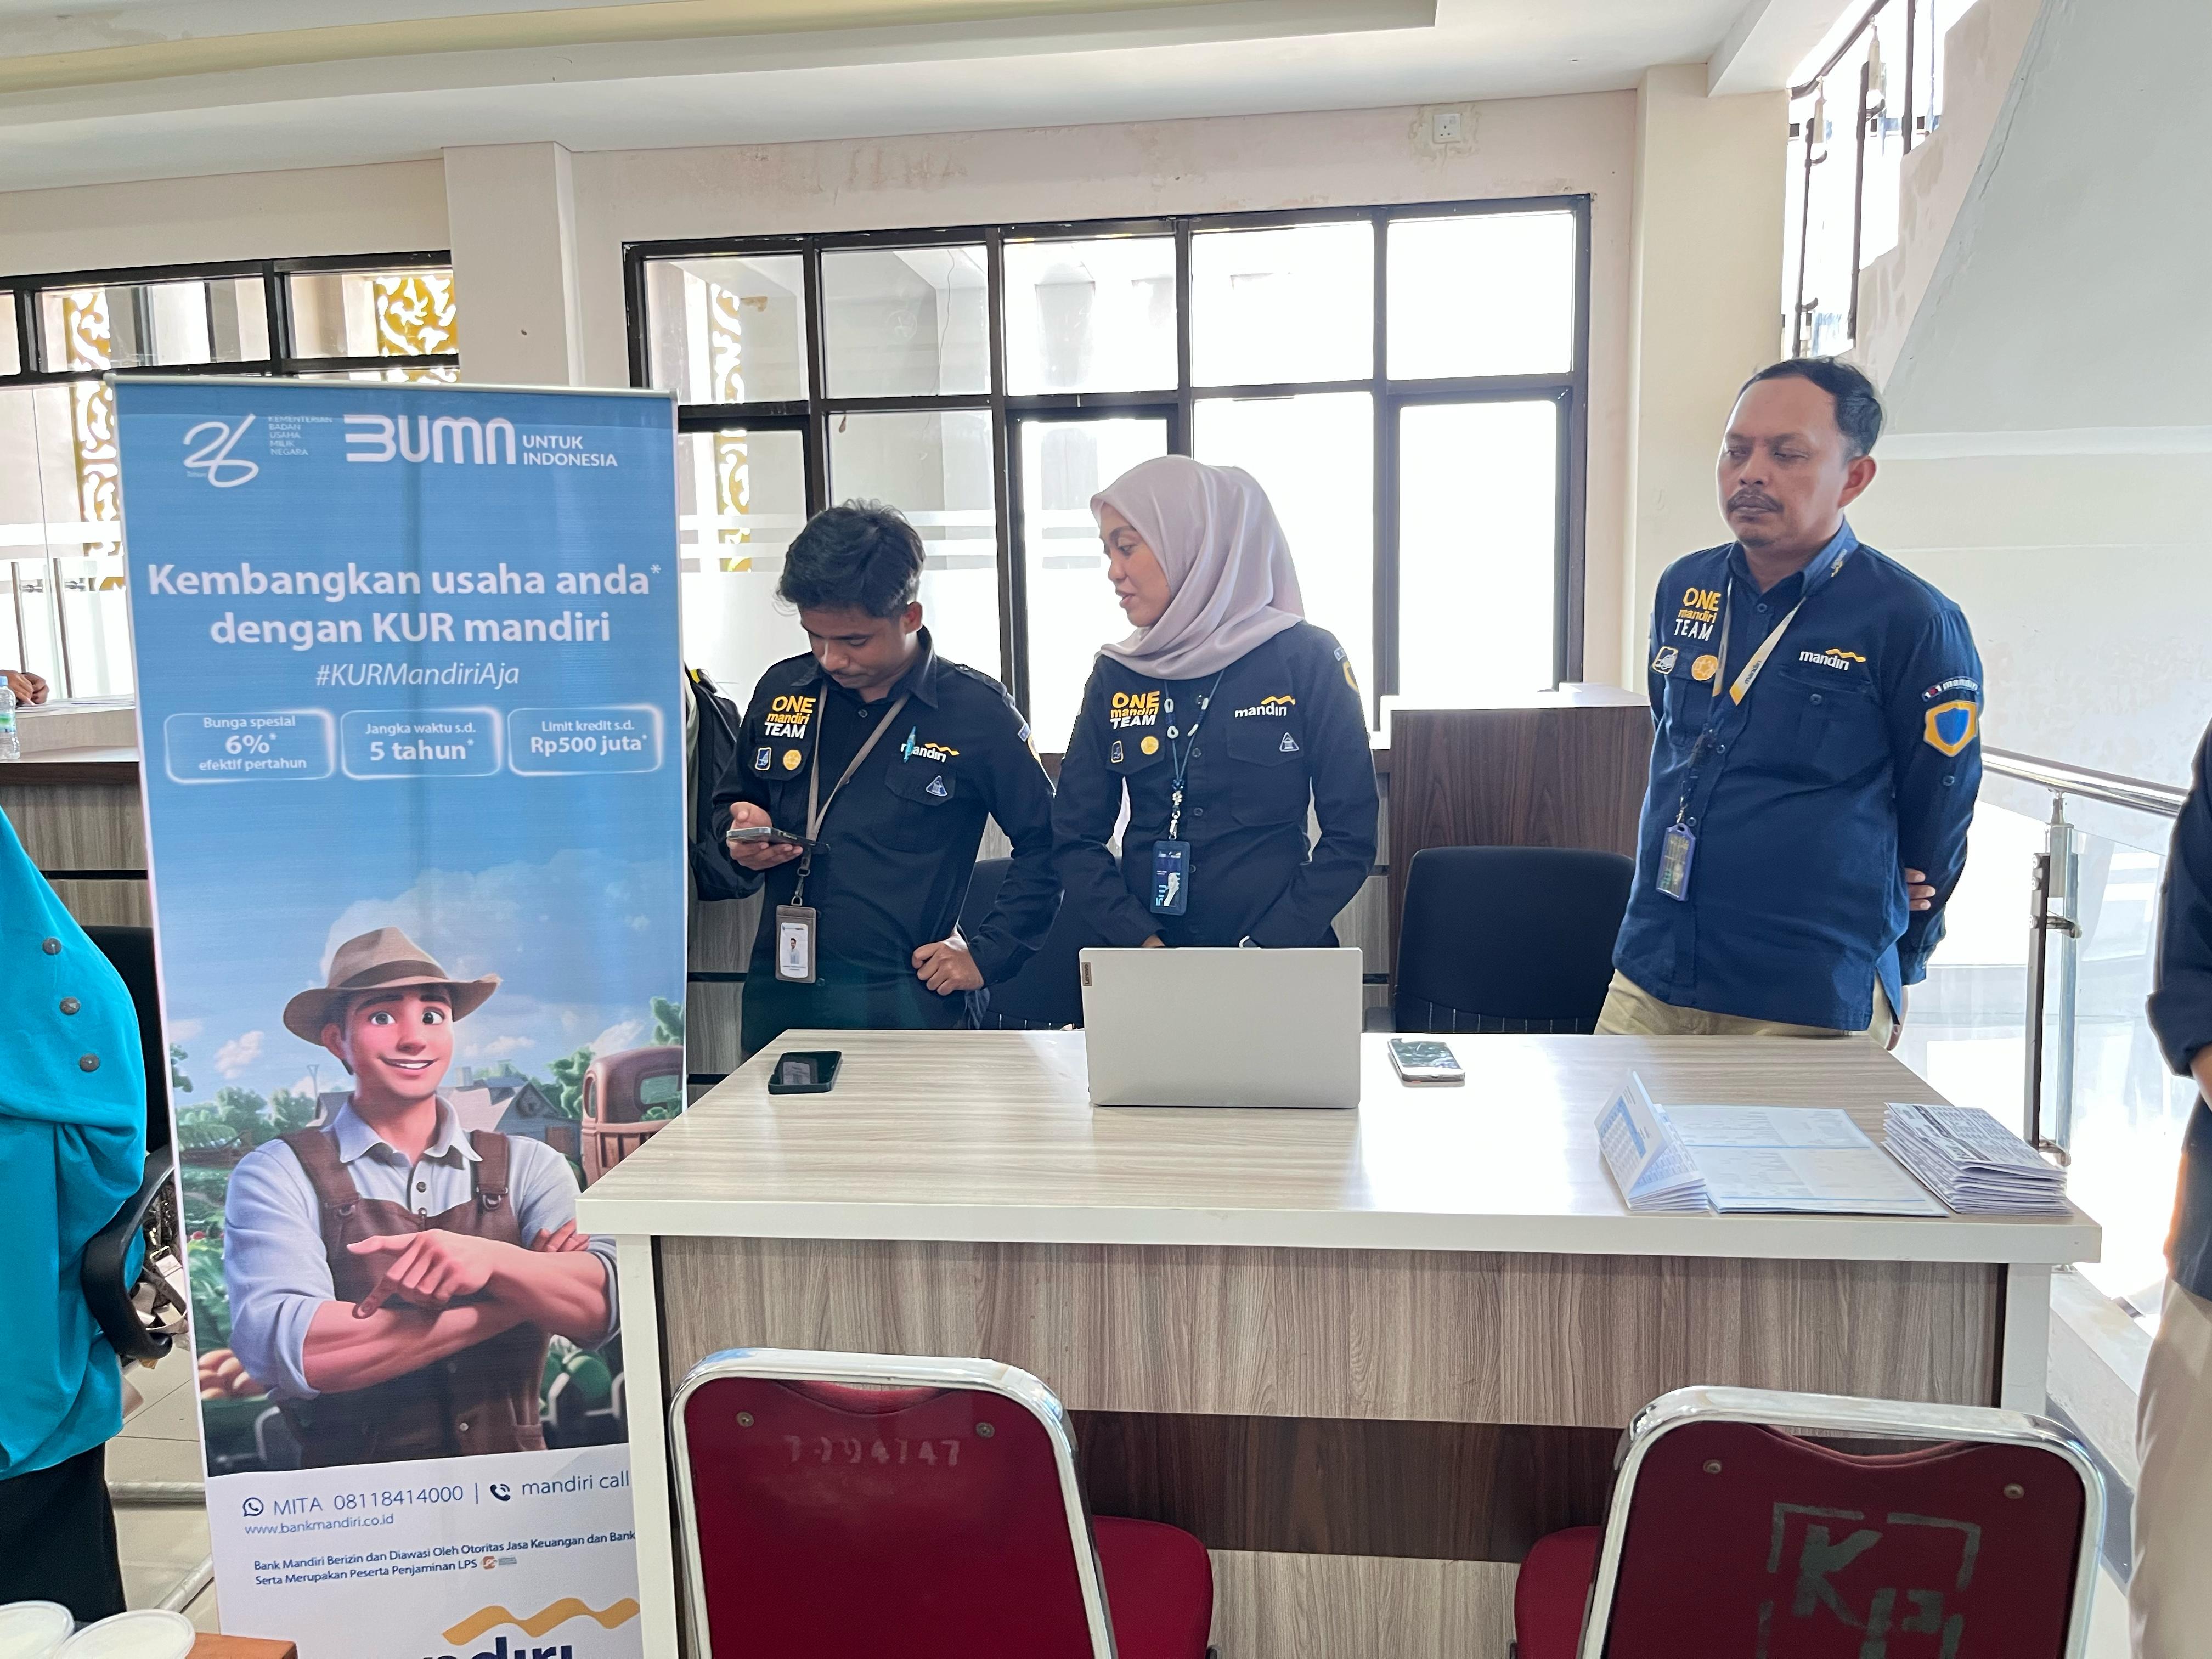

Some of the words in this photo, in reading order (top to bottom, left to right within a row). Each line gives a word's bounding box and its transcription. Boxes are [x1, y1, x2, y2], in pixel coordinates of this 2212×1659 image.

[523, 435, 583, 449] UNTUK
[270, 448, 309, 456] NEGARA
[523, 452, 618, 466] INDONESIA
[148, 562, 421, 602] Kembangkan
[432, 563, 545, 594] usaha
[1683, 588, 1722, 611] ONE
[1678, 609, 1717, 623] mandiri
[210, 612, 362, 651] dengan
[373, 612, 455, 642] KUR
[465, 611, 610, 641] mandiri
[1674, 618, 1713, 641] TEAM
[316, 662, 519, 690] #KURMandiriAja
[772, 695, 816, 713] ONE
[1112, 691, 1160, 709] ONE
[766, 713, 810, 725] mandiri
[1111, 707, 1159, 718] mandiri
[203, 717, 247, 730] Bunga
[250, 715, 296, 730] spesial
[365, 723, 411, 737] Jangka
[414, 723, 452, 734] waktu
[455, 722, 476, 733] s.d.
[542, 720, 573, 732] Limit
[575, 720, 612, 732] kredit
[614, 720, 635, 731] s.d.
[764, 721, 806, 739] TEAM
[1110, 715, 1156, 730] TEAM
[370, 741, 385, 761] 5
[531, 736, 596, 757] Rp500
[199, 758, 241, 771] efektif
[245, 758, 307, 772] pertahun
[274, 1497, 324, 1516] MITA
[334, 1485, 464, 1510] 08118414000
[522, 1475, 593, 1496] mandiri
[599, 1470, 629, 1488] call
[245, 1513, 394, 1534] www.bankmandiri.co.id
[255, 1560, 281, 1570] Bank
[283, 1557, 325, 1569] Mandiri
[327, 1555, 364, 1566] Berizin
[366, 1552, 387, 1562] dan
[390, 1548, 431, 1560] Diawasi
[433, 1544, 459, 1557] Oleh
[461, 1542, 504, 1554] Otoritas
[506, 1541, 529, 1551] Jasa
[531, 1538, 584, 1549] Keuangan
[587, 1534, 607, 1544] dan
[610, 1531, 635, 1541] Bank
[256, 1575, 283, 1585] Serta
[285, 1571, 347, 1584] Merupakan
[350, 1567, 389, 1578] Peserta
[392, 1561, 455, 1577] Penjaminan
[458, 1559, 478, 1570] LPS
